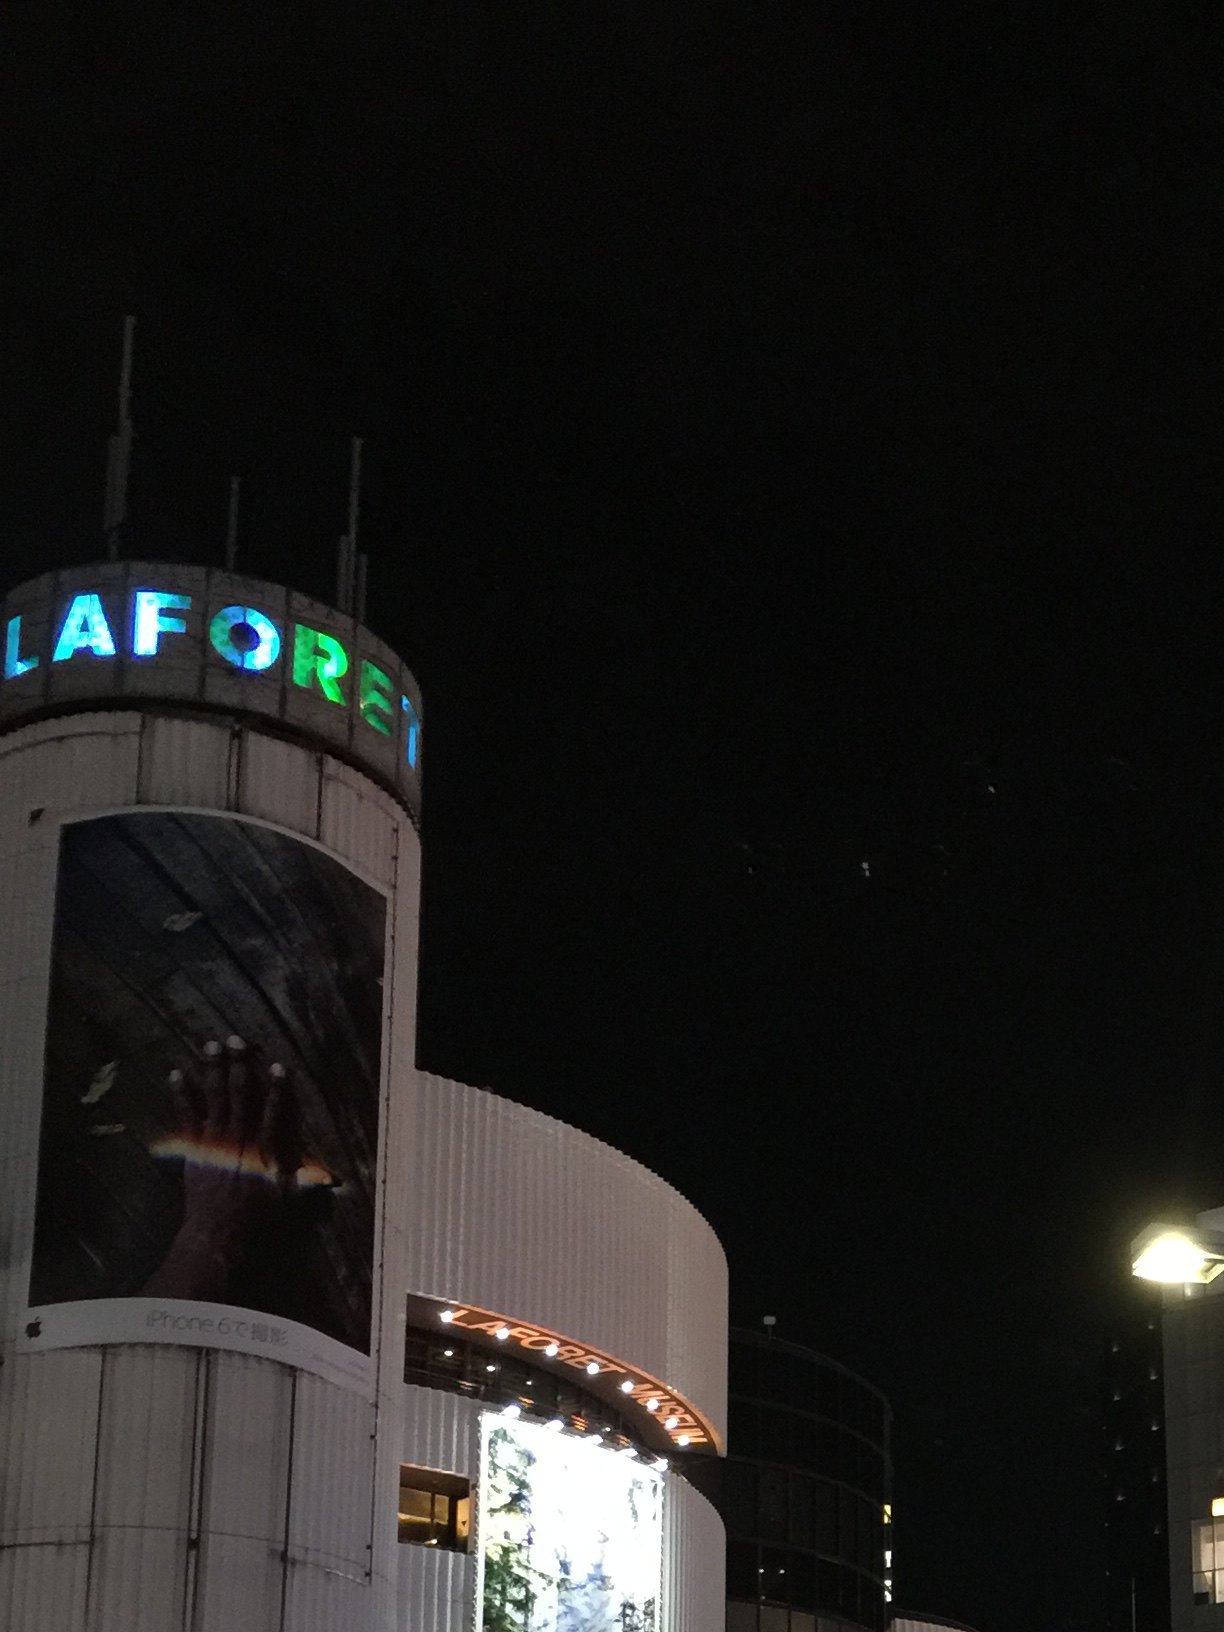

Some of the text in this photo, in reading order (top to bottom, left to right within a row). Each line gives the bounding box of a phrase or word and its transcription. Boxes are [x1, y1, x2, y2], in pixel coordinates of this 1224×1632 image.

[4, 589, 418, 769] LAFORET
[146, 1309, 213, 1331] iPhone
[450, 1308, 708, 1445] LAFORET MUSEUM
